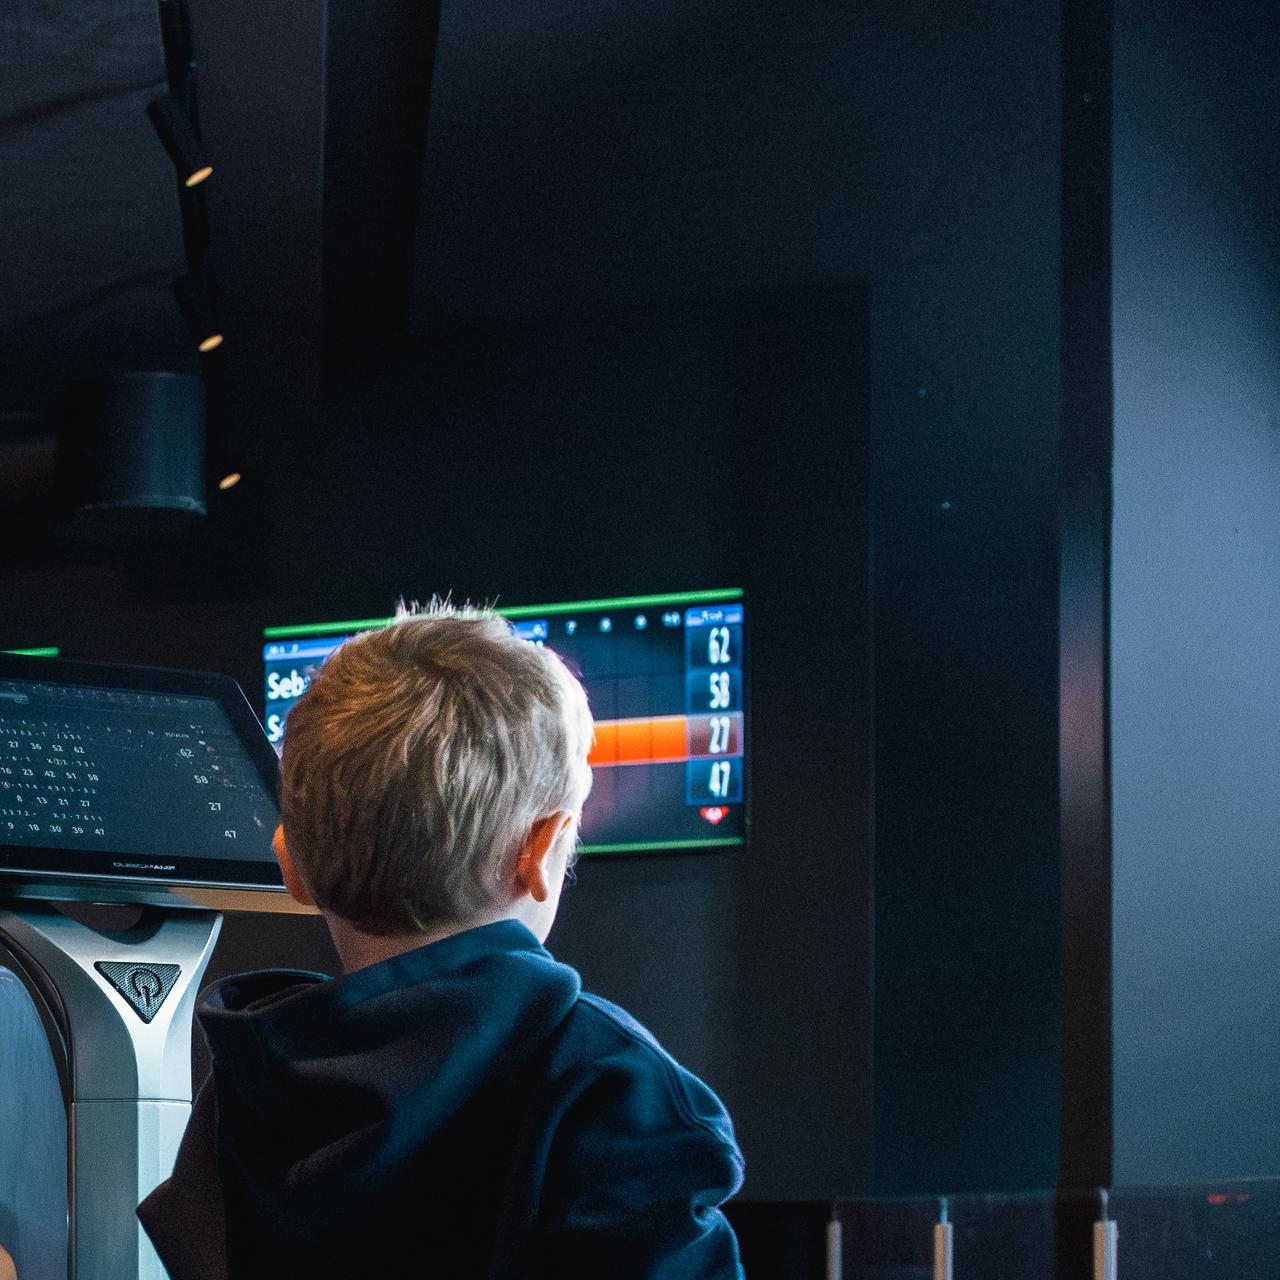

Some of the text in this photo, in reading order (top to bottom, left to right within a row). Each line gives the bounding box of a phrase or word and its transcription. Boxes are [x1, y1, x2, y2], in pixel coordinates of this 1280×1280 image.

[708, 627, 731, 664] 62
[268, 669, 311, 699] Seb
[708, 671, 731, 709] 58
[709, 716, 731, 754] 27
[30, 742, 42, 750] 36
[52, 744, 64, 752] 52
[74, 746, 86, 754] 62
[180, 748, 195, 759] 62
[44, 770, 56, 778] 42
[194, 775, 208, 784] 58
[708, 761, 731, 798] 47
[36, 797, 48, 805] 13
[58, 798, 69, 806] 21
[209, 802, 221, 811] 27
[8, 822, 14, 830] 9
[50, 825, 62, 833] 30
[95, 828, 105, 836] 47
[225, 830, 236, 838] 47
